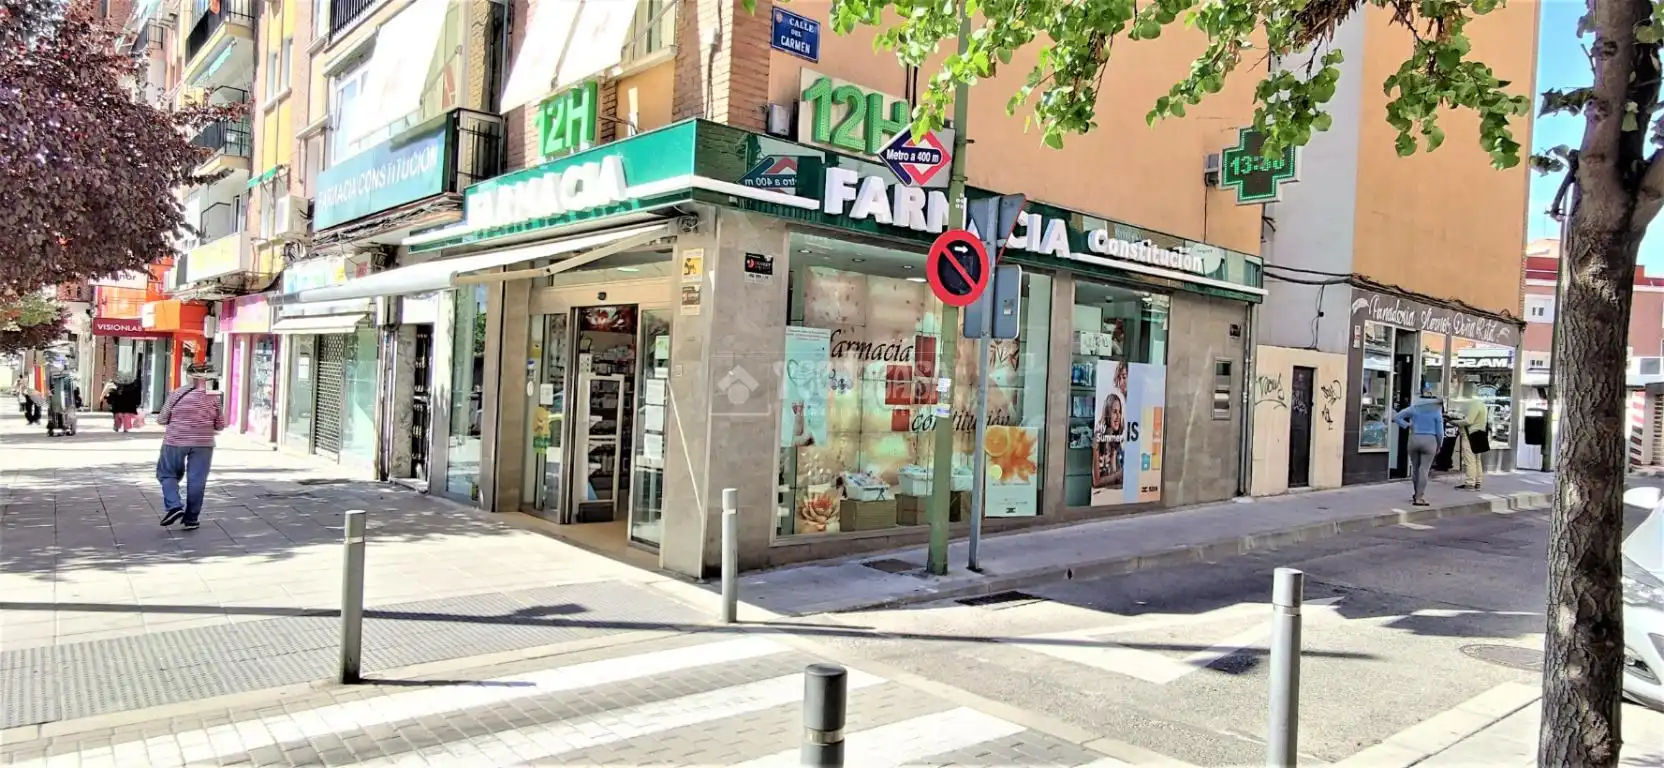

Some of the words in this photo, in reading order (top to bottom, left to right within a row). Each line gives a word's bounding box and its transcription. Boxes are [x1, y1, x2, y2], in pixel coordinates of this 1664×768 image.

[789, 17, 815, 33] CALLE
[781, 35, 811, 54] CARMEN
[534, 80, 598, 157] 12H
[802, 75, 908, 155] 12H
[886, 149, 909, 160] Metro
[910, 153, 916, 161] a
[917, 152, 931, 162] 400
[932, 154, 939, 162] m
[1088, 228, 1202, 273] Constitución
[829, 328, 914, 362] farmacia
[1126, 421, 1139, 442] IS
